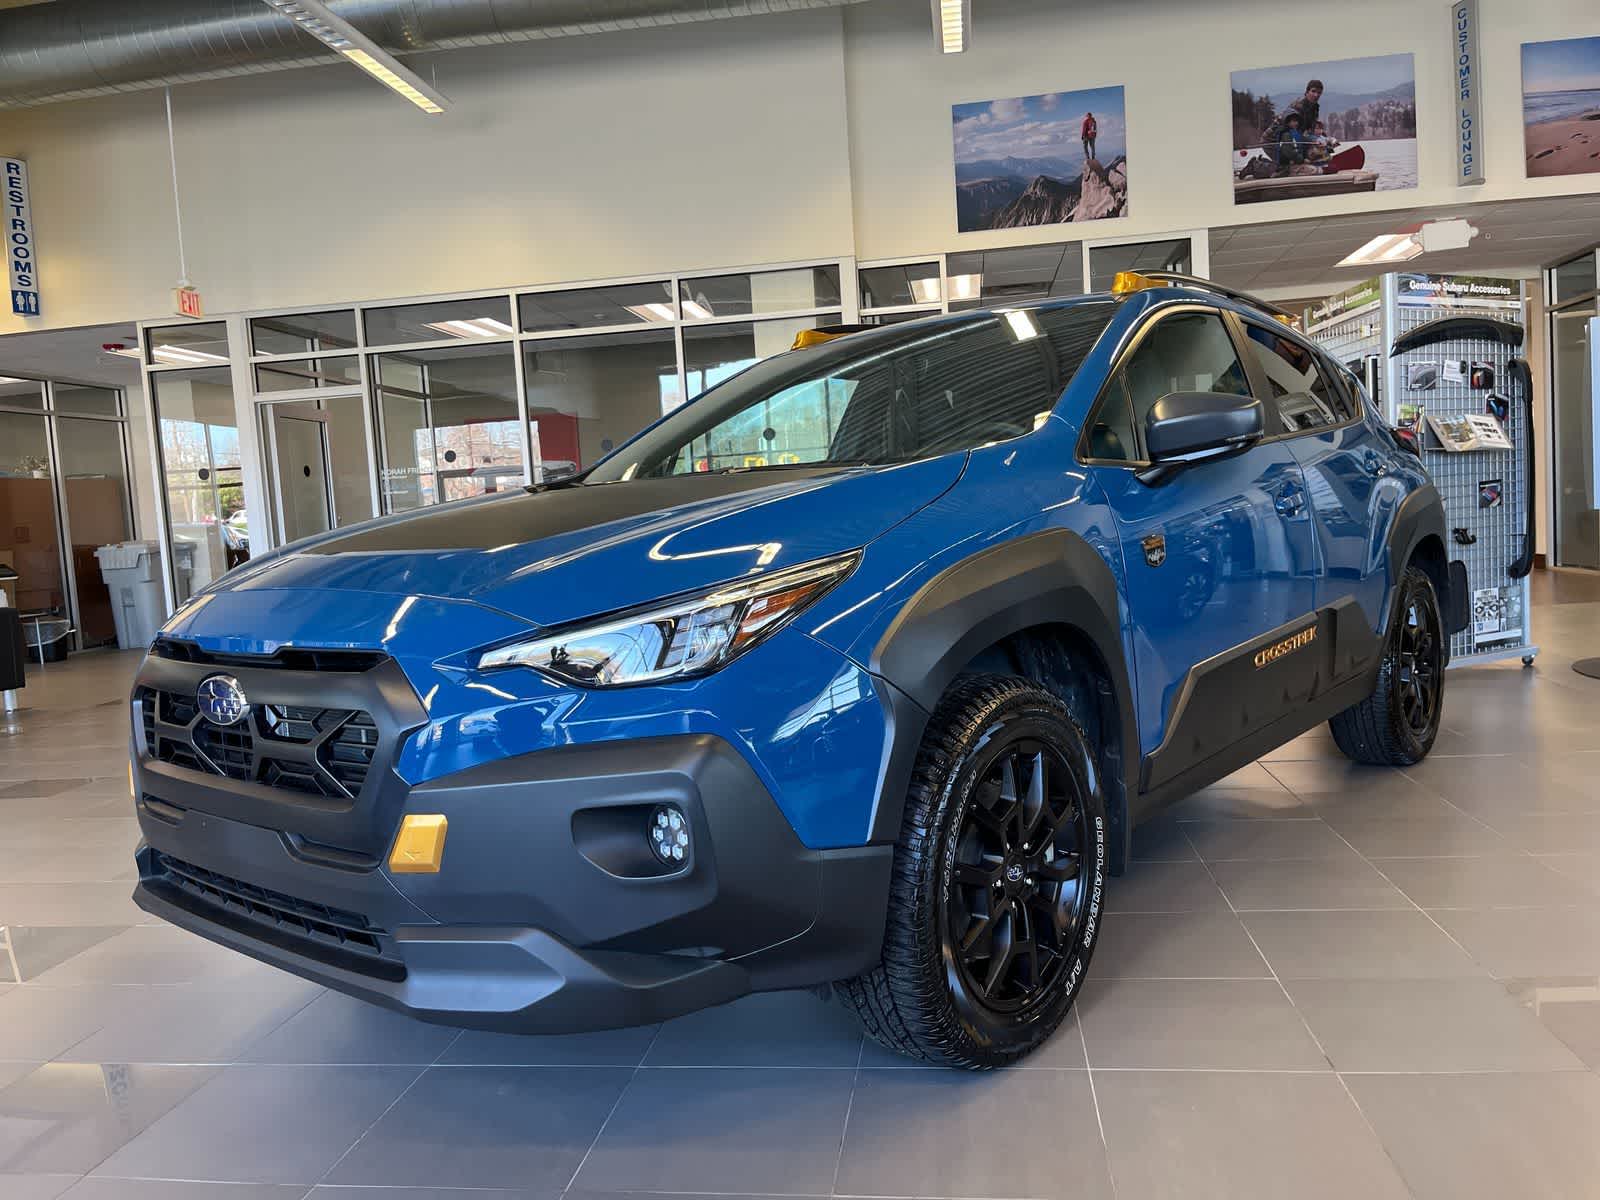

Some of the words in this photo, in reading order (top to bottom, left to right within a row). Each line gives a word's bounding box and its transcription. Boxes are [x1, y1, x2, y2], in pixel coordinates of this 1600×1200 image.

[1457, 8, 1470, 101] CUSTOMER
[1461, 109, 1472, 176] LOUNGE
[6, 162, 32, 287] RESTROOMS
[180, 290, 200, 316] EXIT
[1409, 280, 1441, 290] Genuine
[1443, 282, 1469, 293] Subaru
[1470, 283, 1511, 295] Accessories
[1254, 625, 1317, 667] CROSSTREK
[1084, 816, 1104, 948] GEOLANDAR
[1065, 958, 1082, 996] A/T
